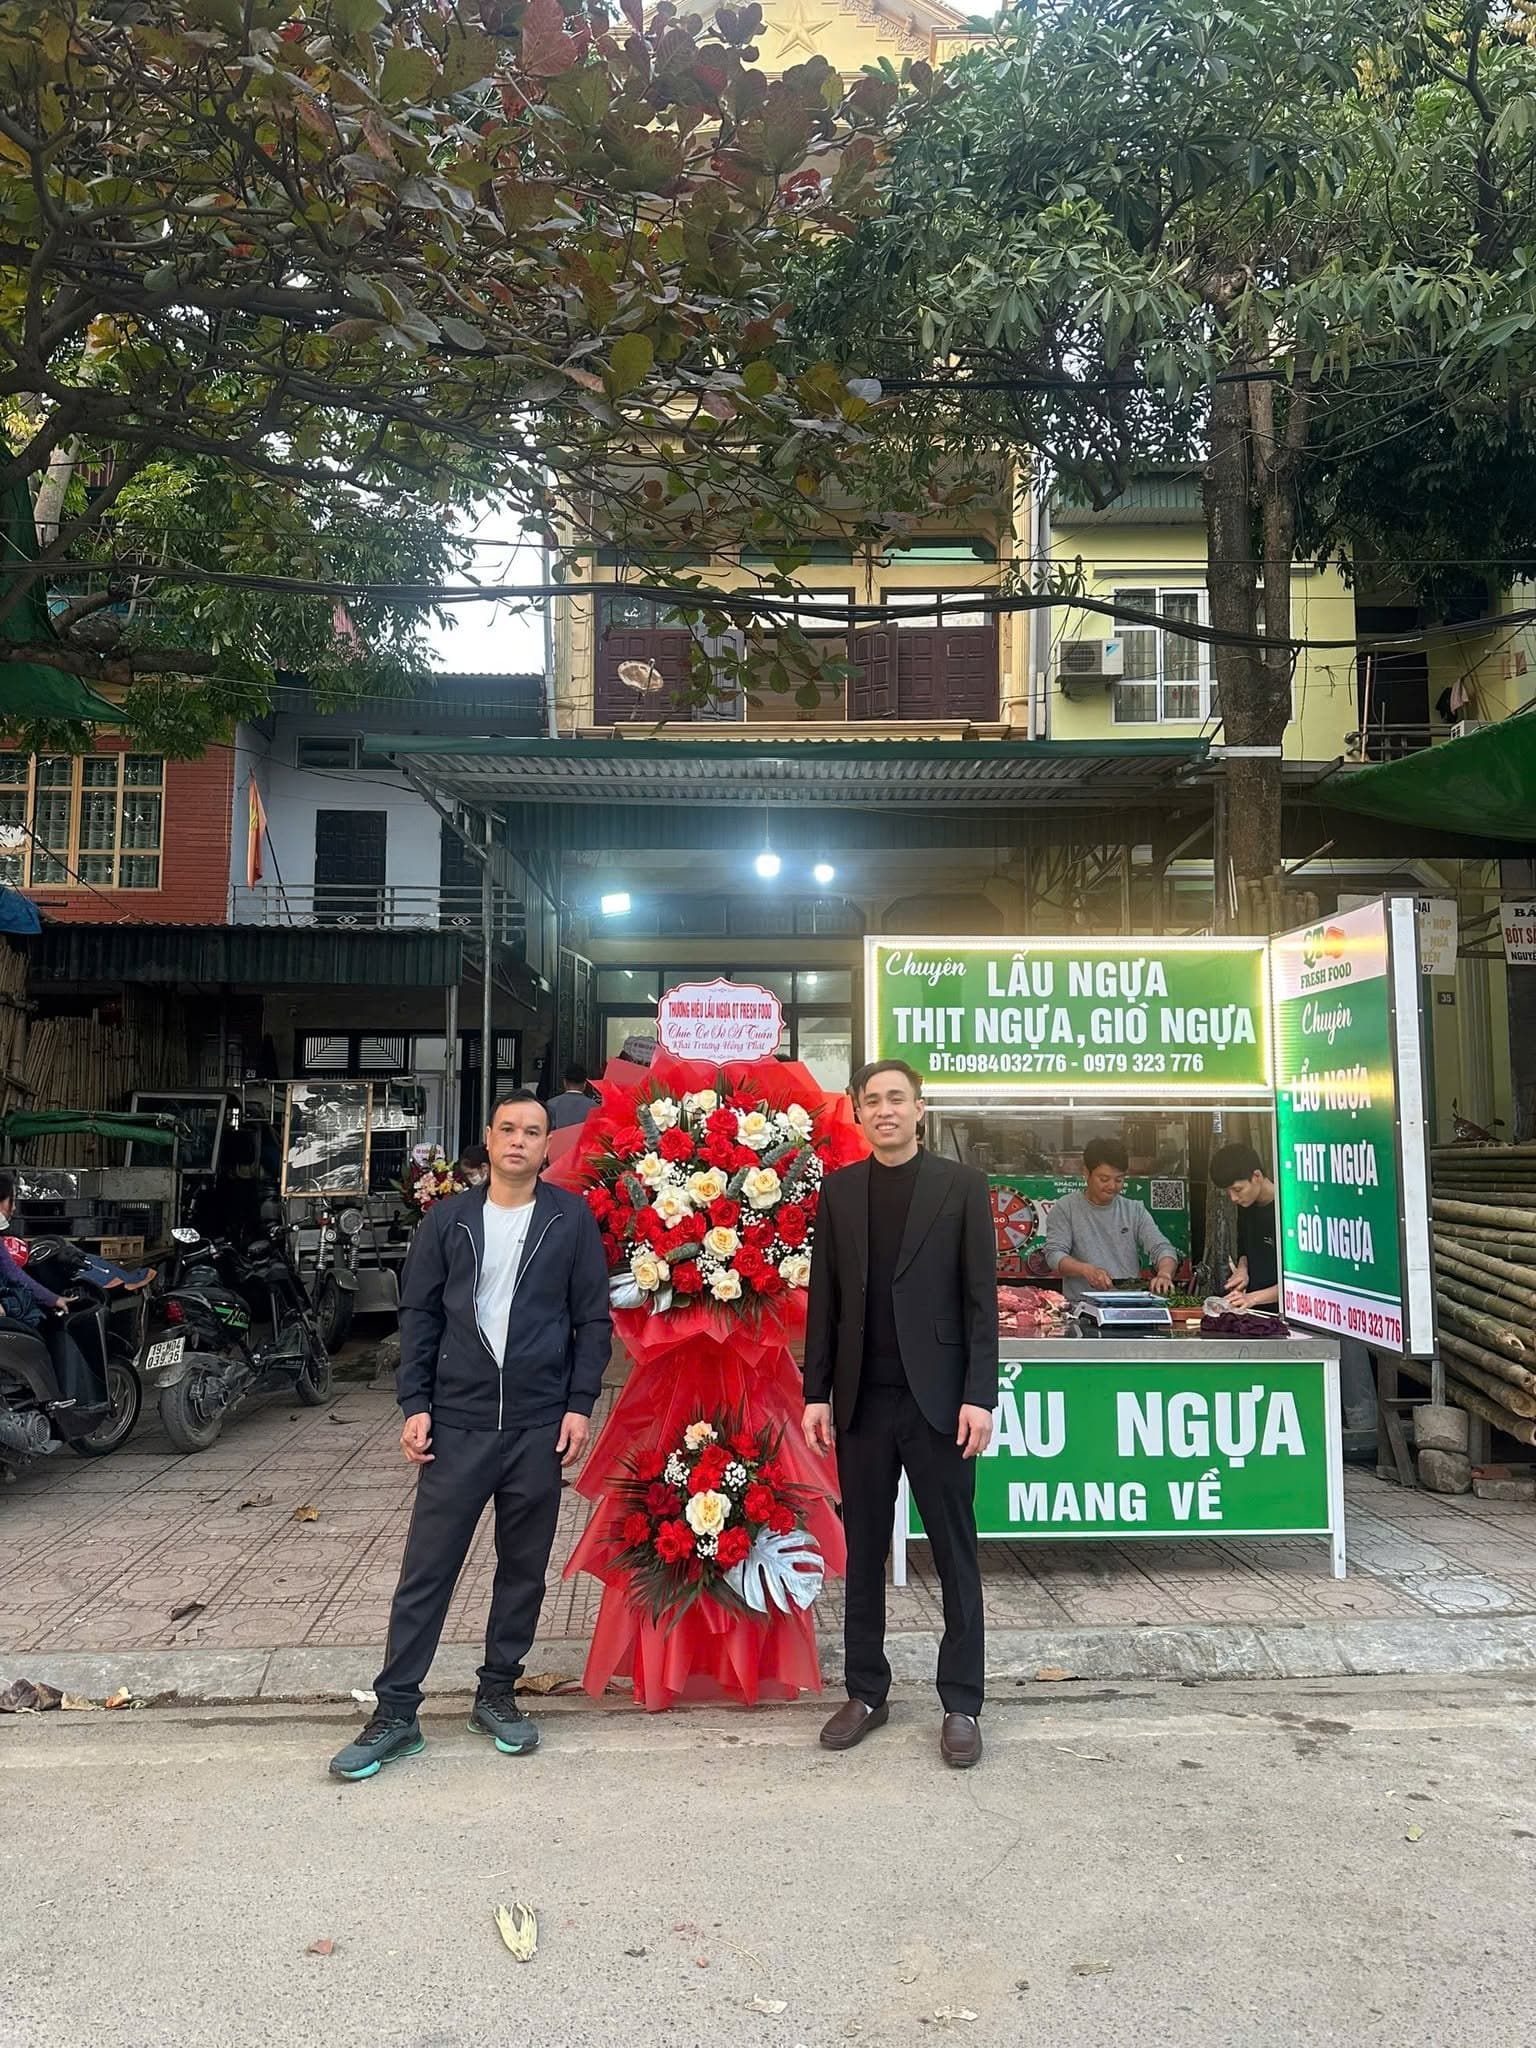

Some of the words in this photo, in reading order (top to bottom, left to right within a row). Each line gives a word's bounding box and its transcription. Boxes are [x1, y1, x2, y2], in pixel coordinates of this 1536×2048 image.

[885, 951, 967, 986] Chuyên
[1068, 958, 1168, 1003] NGỰA
[1300, 967, 1327, 989] FRESH
[1328, 962, 1352, 982] FOOD
[740, 1002, 757, 1019] FRESH
[758, 1003, 771, 1019] FOOD
[892, 1007, 966, 1050] THỊT
[1160, 1004, 1256, 1050] NGỰA
[1302, 1000, 1353, 1045] Chuyên
[1083, 1053, 1127, 1073] 0979
[1132, 1053, 1166, 1073] 323
[1170, 1053, 1204, 1073] 776
[1324, 1063, 1372, 1118] NGỰA
[1293, 1143, 1326, 1191] THỊT
[1330, 1140, 1378, 1195] NGỰA
[1297, 1205, 1323, 1254] GIÒ
[1326, 1216, 1374, 1271] NGỰA
[1314, 1298, 1326, 1321] 032
[1328, 1302, 1341, 1326] 776
[1347, 1307, 1367, 1333] 0979
[1368, 1312, 1384, 1338] 323
[1385, 1317, 1401, 1343] 776
[976, 1363, 1065, 1458] ẨU
[1116, 1385, 1306, 1468] NGỰA
[1008, 1481, 1147, 1521] MANG
[1168, 1467, 1222, 1520] VỀ
